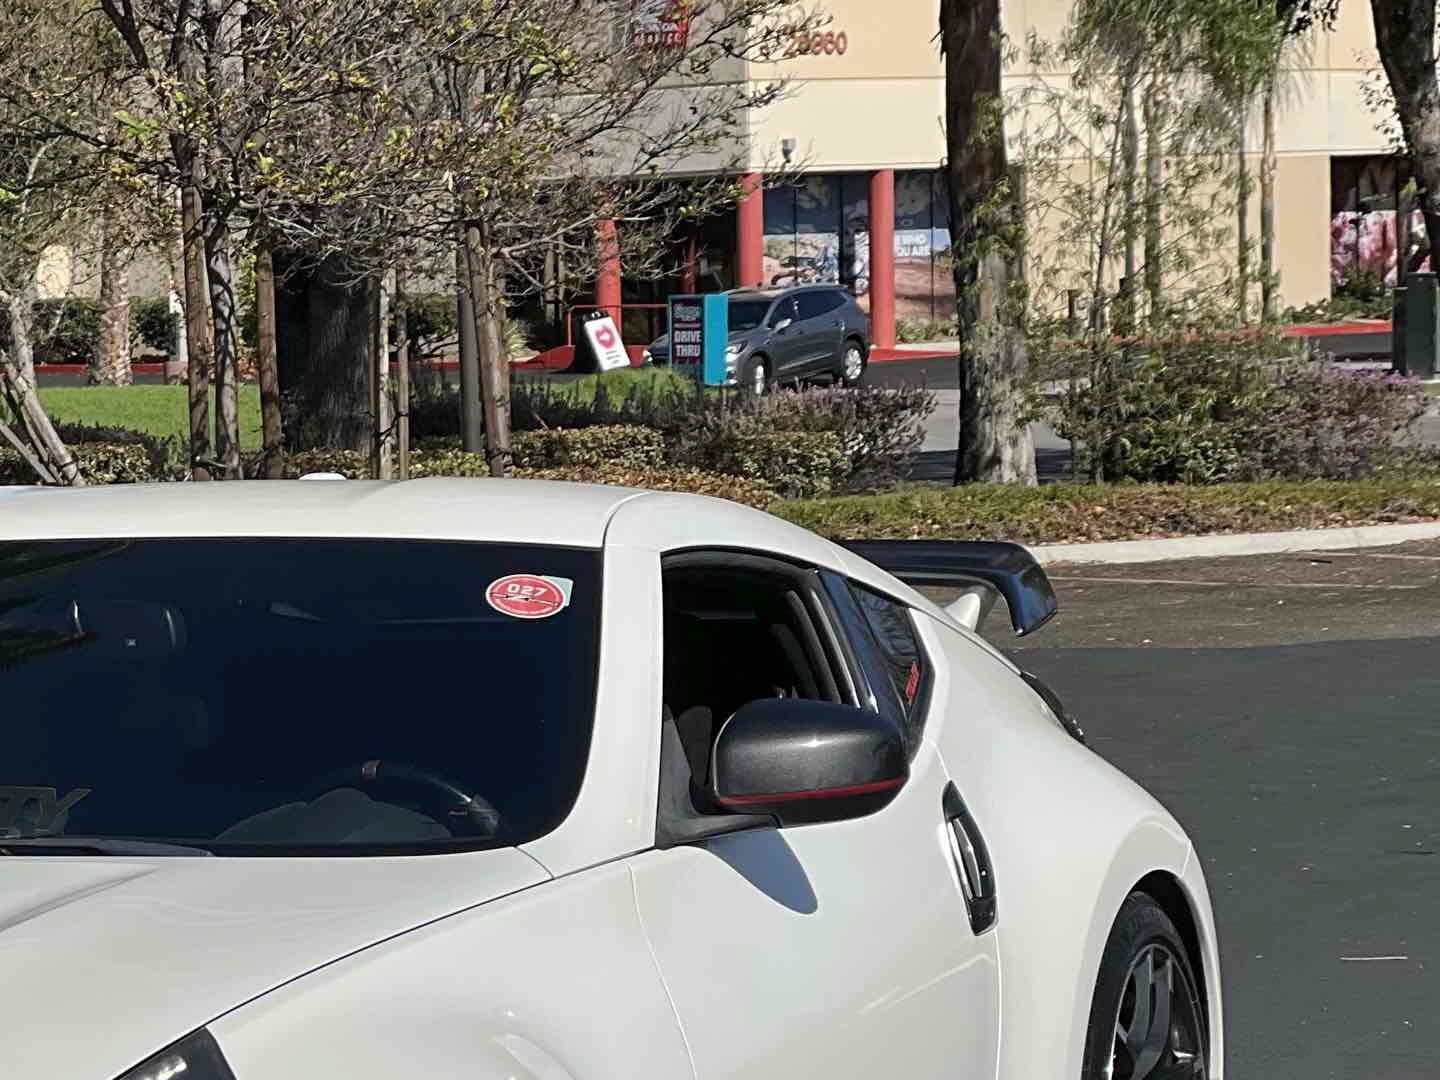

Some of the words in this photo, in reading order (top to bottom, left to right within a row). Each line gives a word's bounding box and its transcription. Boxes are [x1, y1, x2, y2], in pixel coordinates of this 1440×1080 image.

[674, 331, 702, 343] DRIVE
[675, 344, 701, 357] THRU
[507, 583, 548, 597] 027
